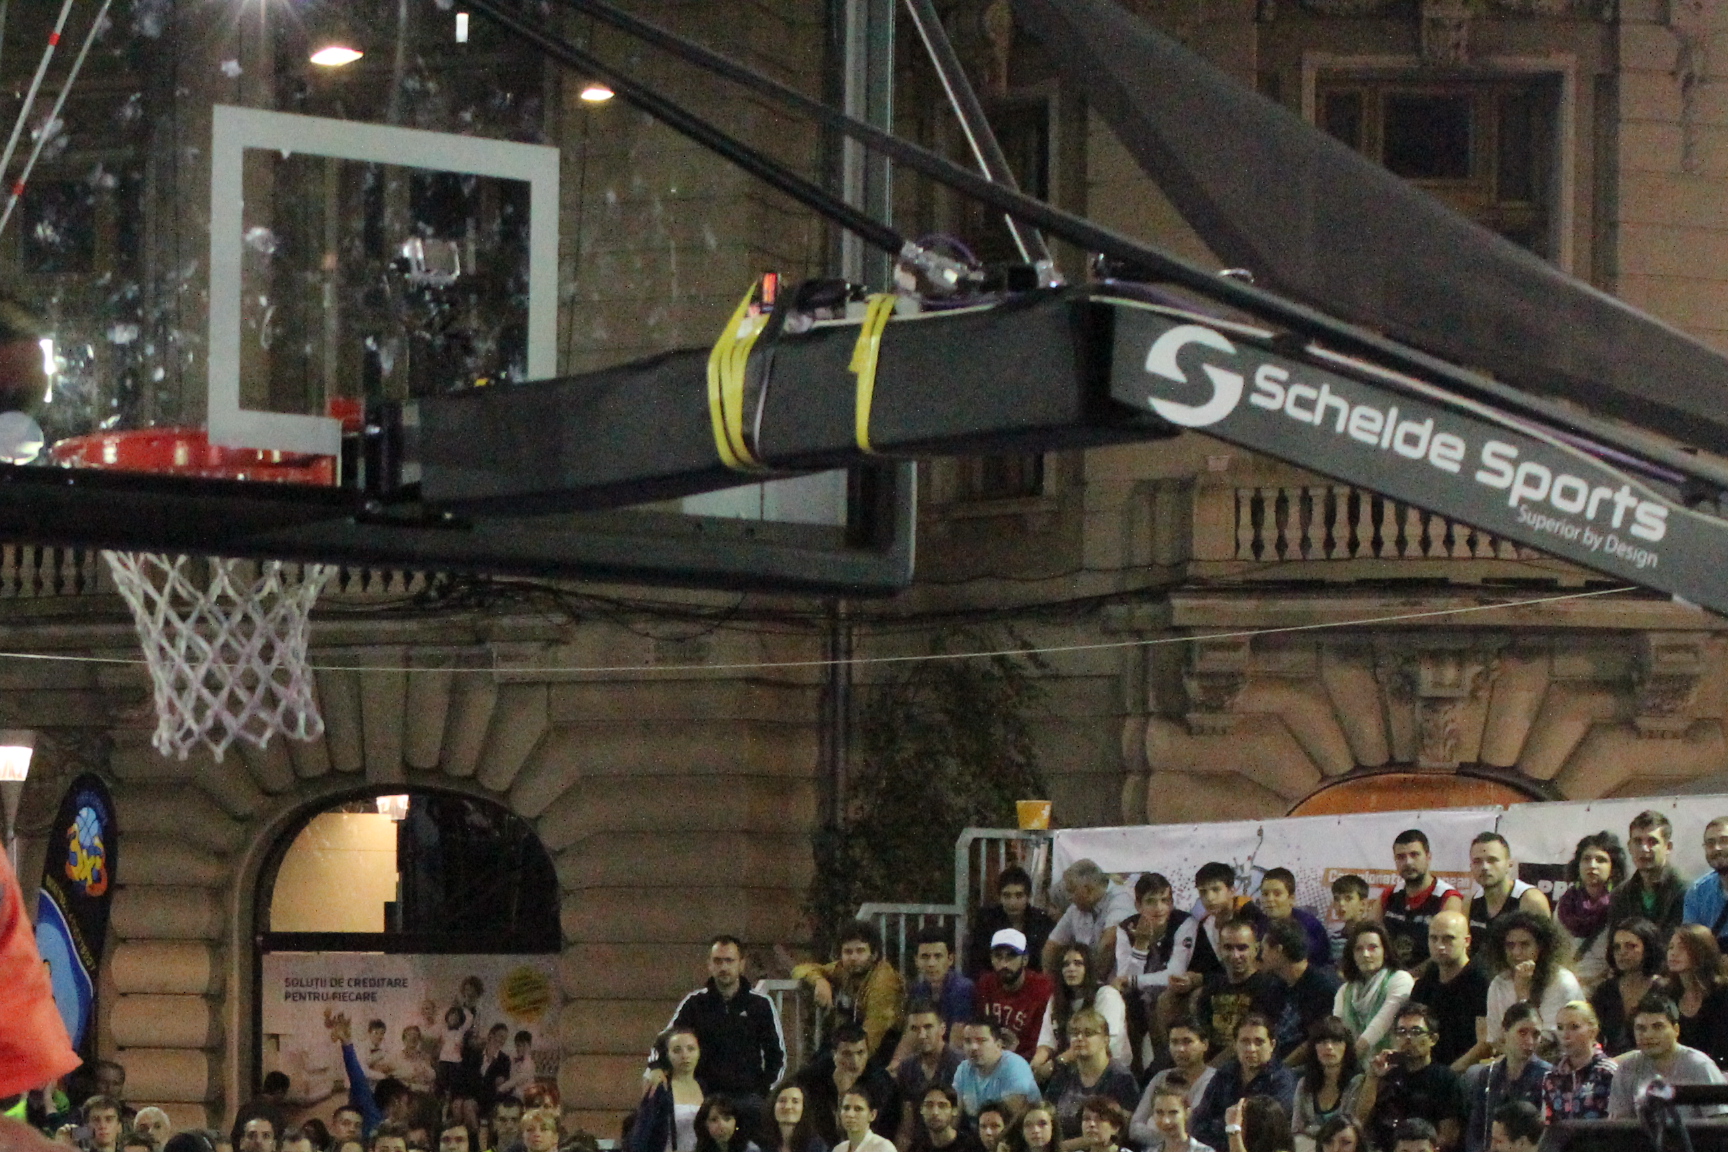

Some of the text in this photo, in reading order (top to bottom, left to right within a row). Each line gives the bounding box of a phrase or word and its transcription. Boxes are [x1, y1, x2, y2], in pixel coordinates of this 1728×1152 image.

[1249, 363, 1670, 542] Schelde Sports
[1518, 504, 1659, 568] Superior by Design
[284, 991, 378, 1002] PENTRU FIECARE
[330, 977, 345, 988] DE
[347, 977, 409, 988] CREDITARE
